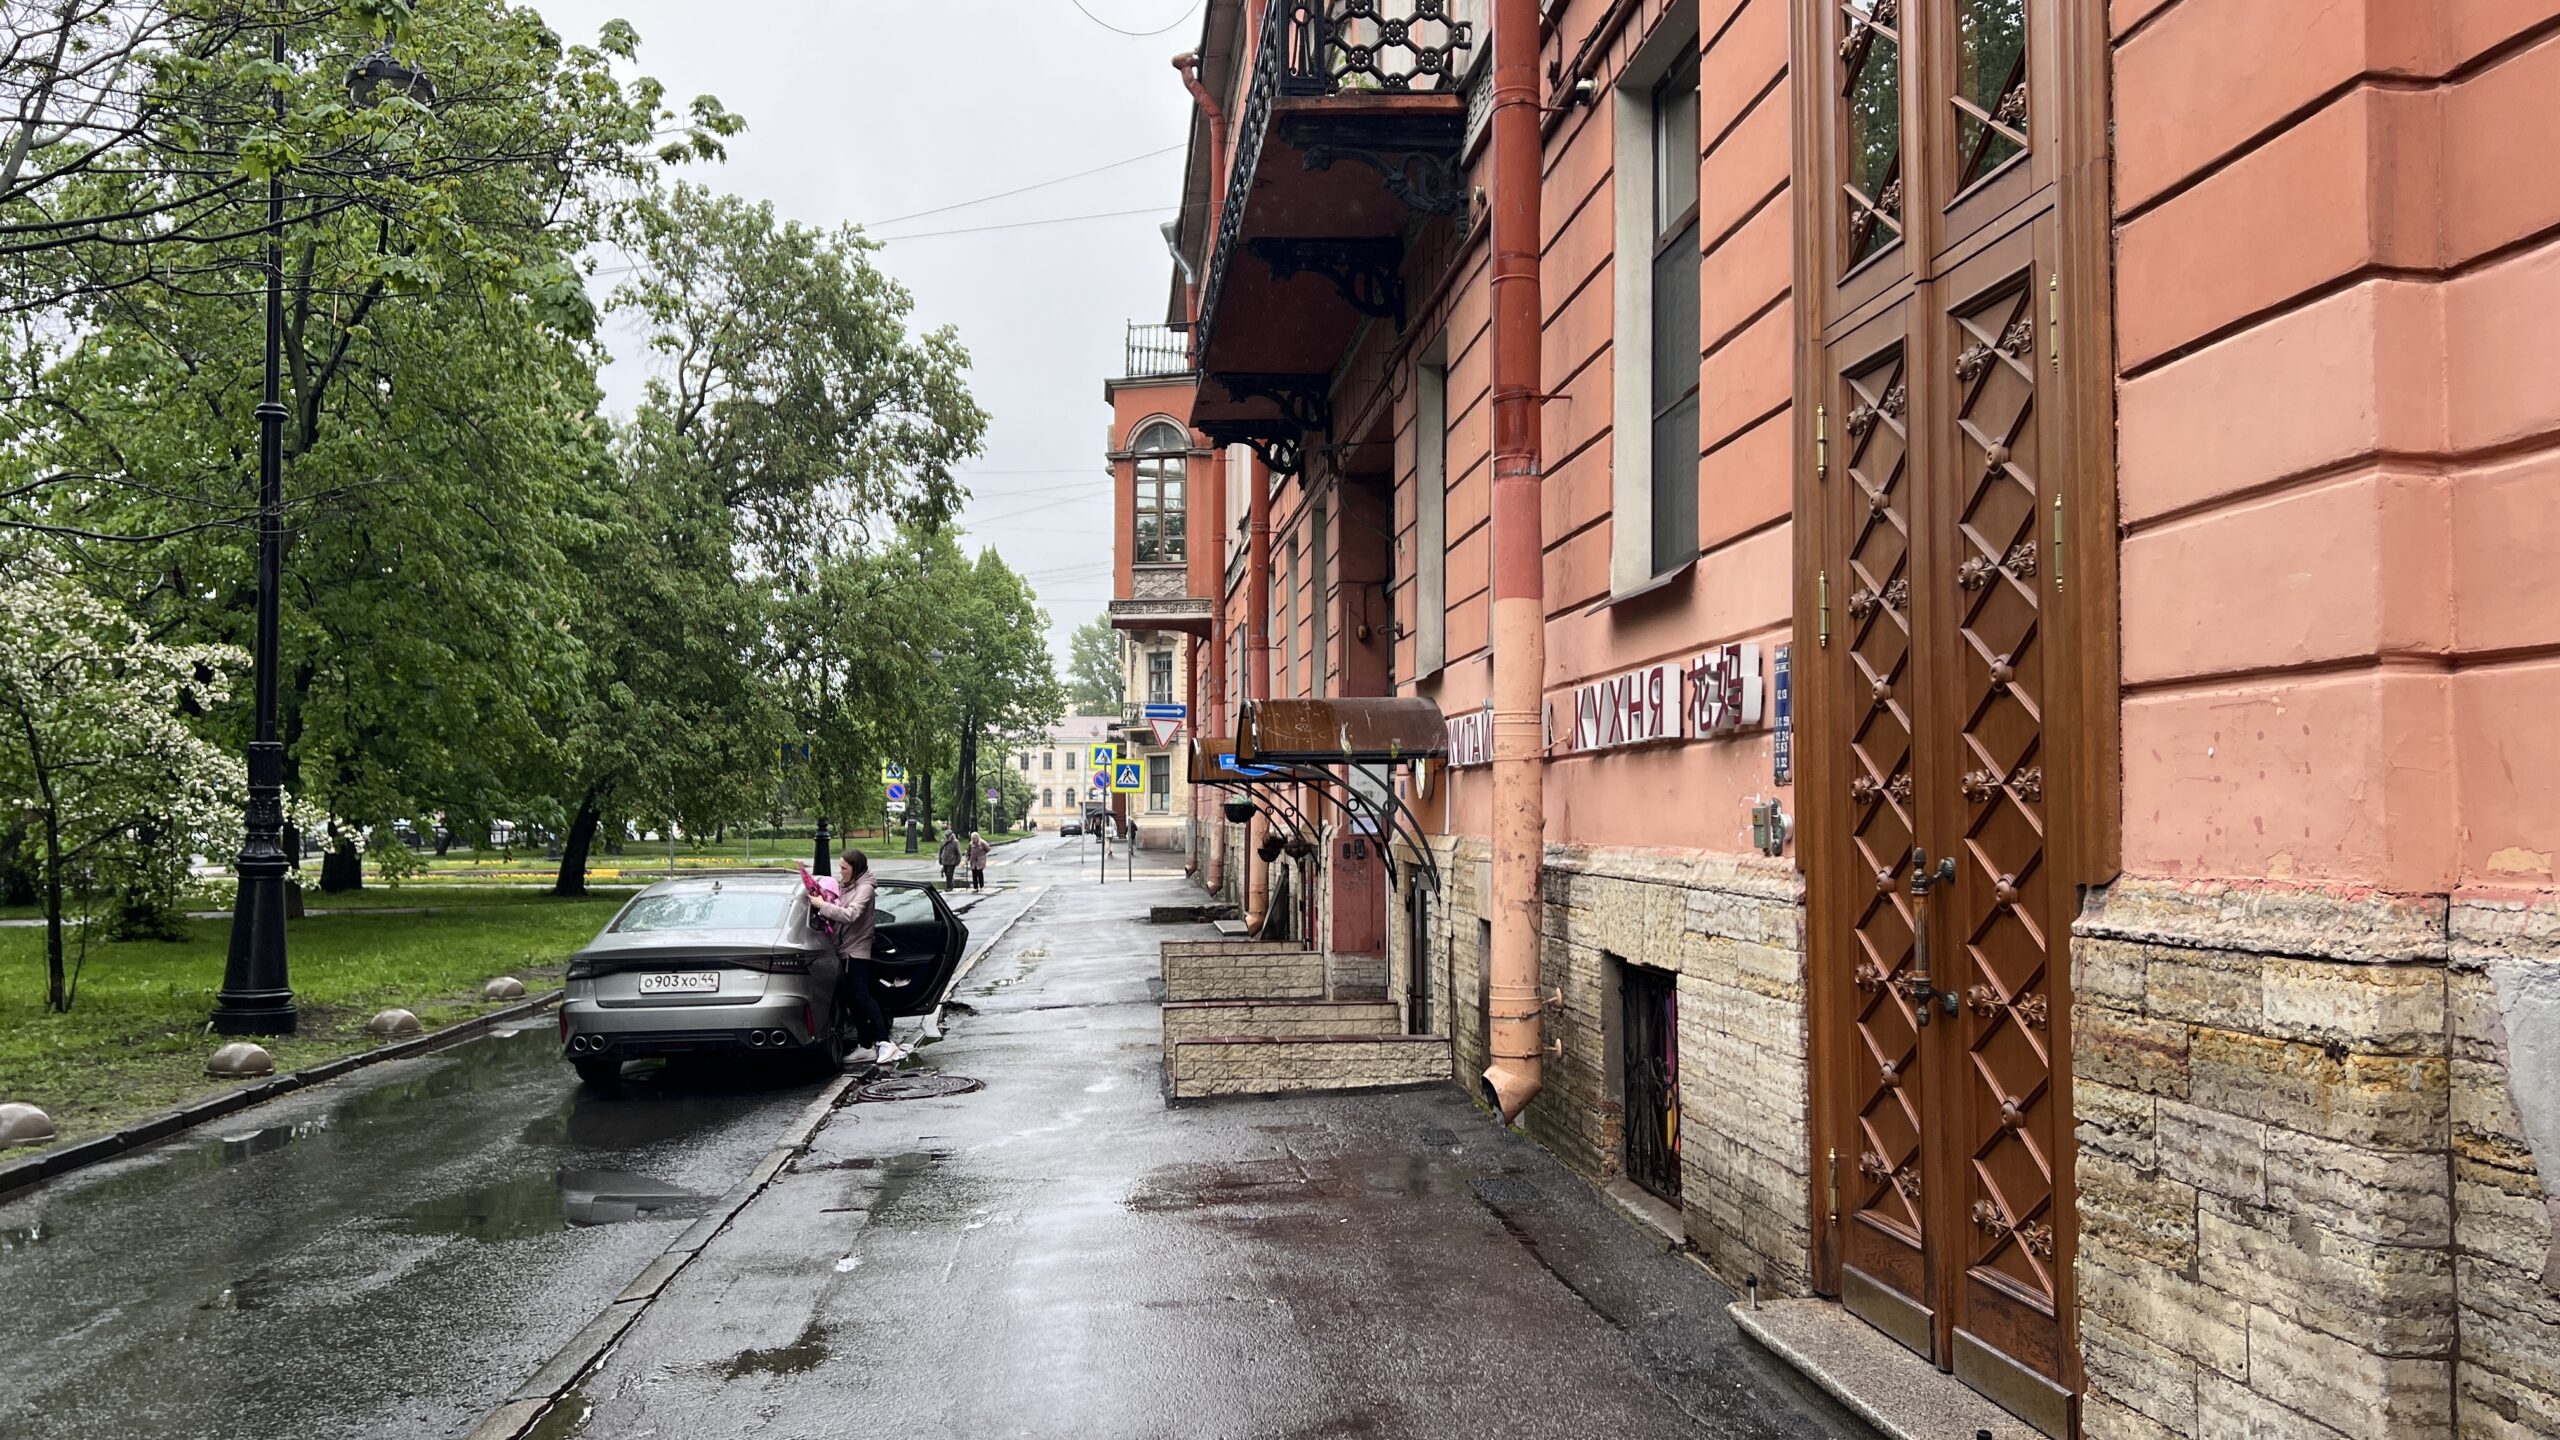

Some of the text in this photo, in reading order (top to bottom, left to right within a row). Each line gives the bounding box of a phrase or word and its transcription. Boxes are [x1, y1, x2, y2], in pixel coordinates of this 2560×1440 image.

[1447, 666, 1664, 765] КИТАЙ КУХНЯ
[700, 973, 714, 983] 44
